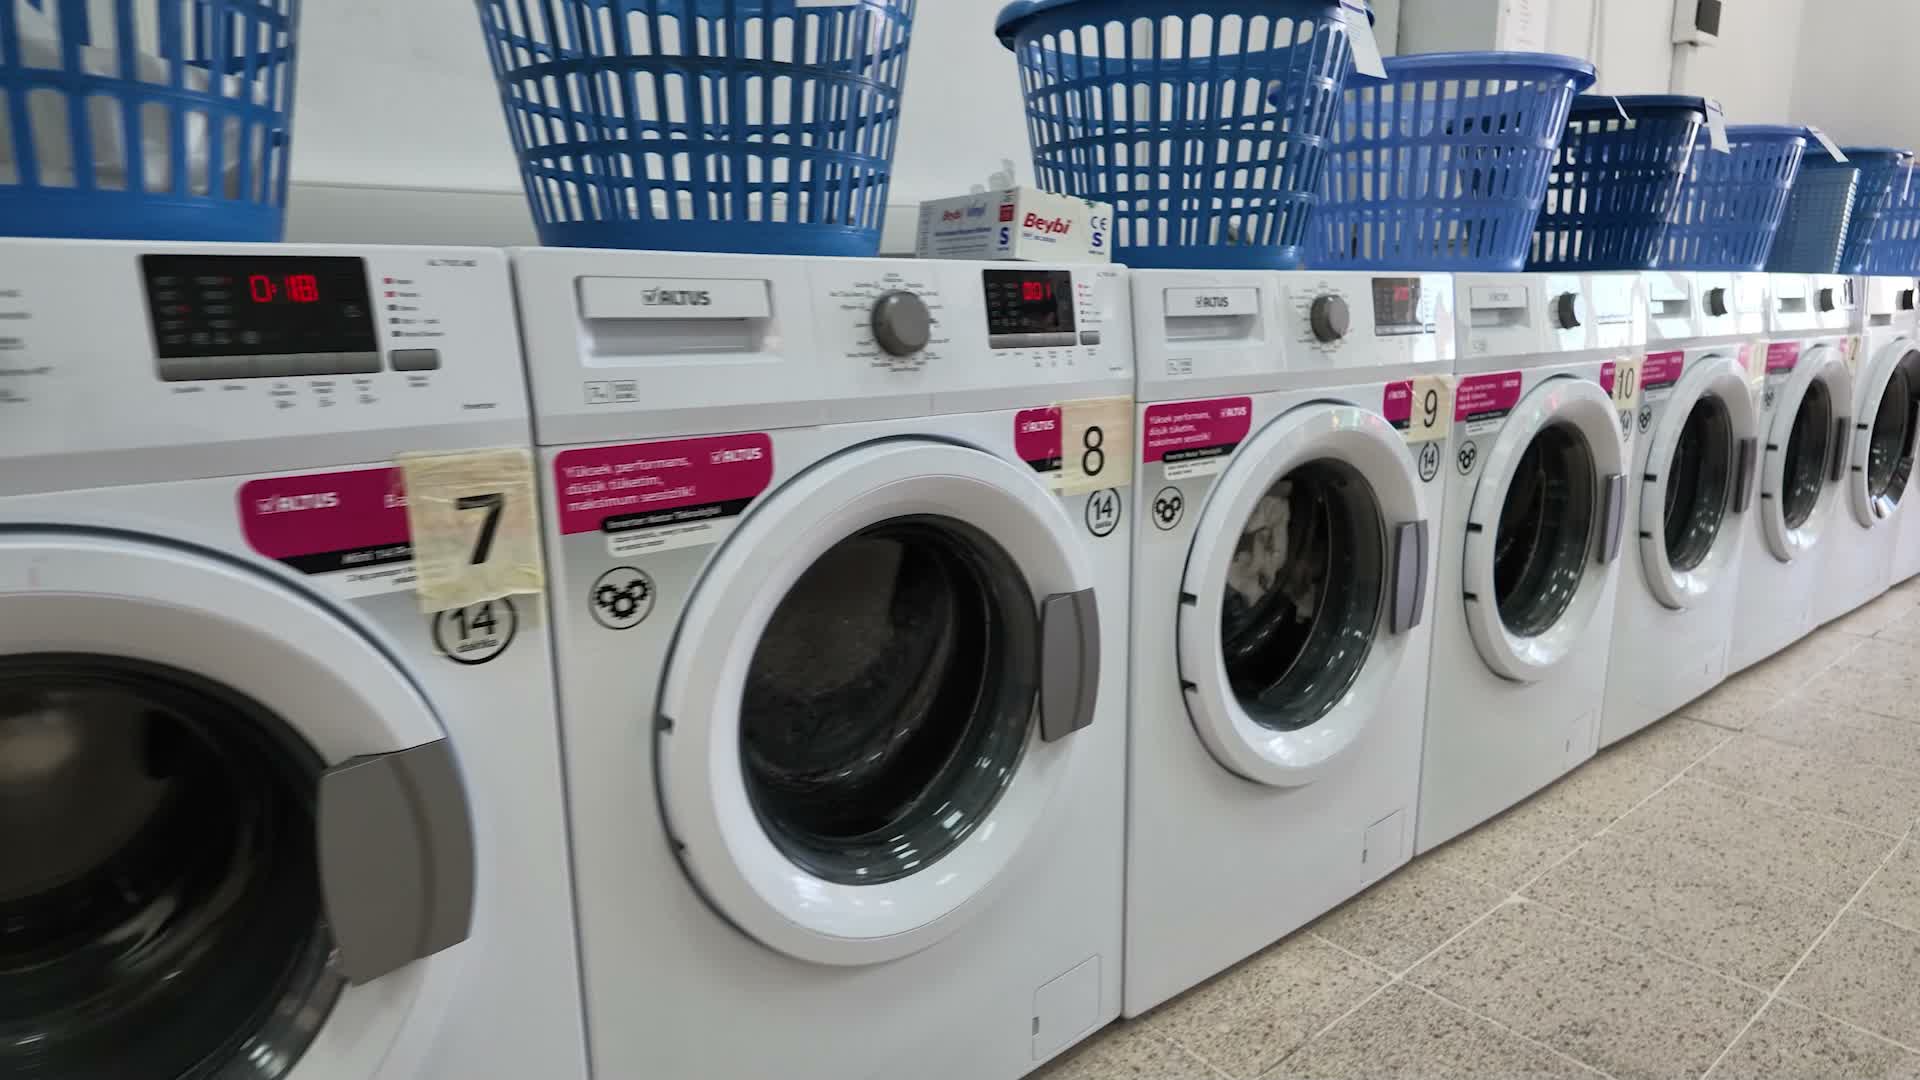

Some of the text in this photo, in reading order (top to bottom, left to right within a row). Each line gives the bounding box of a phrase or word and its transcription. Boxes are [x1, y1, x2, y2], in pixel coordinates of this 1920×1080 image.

[1023, 212, 1073, 234] Beybi
[1000, 227, 1009, 245] S
[1091, 232, 1103, 247] S
[656, 289, 712, 306] ALTUS
[1617, 366, 1635, 400] 10
[1423, 388, 1438, 428] 9
[719, 447, 763, 462] ALTUS
[1082, 425, 1105, 477] 8
[1423, 450, 1436, 470] 14
[1092, 495, 1114, 521] 14
[455, 493, 505, 566] 7
[448, 602, 498, 641] 14
